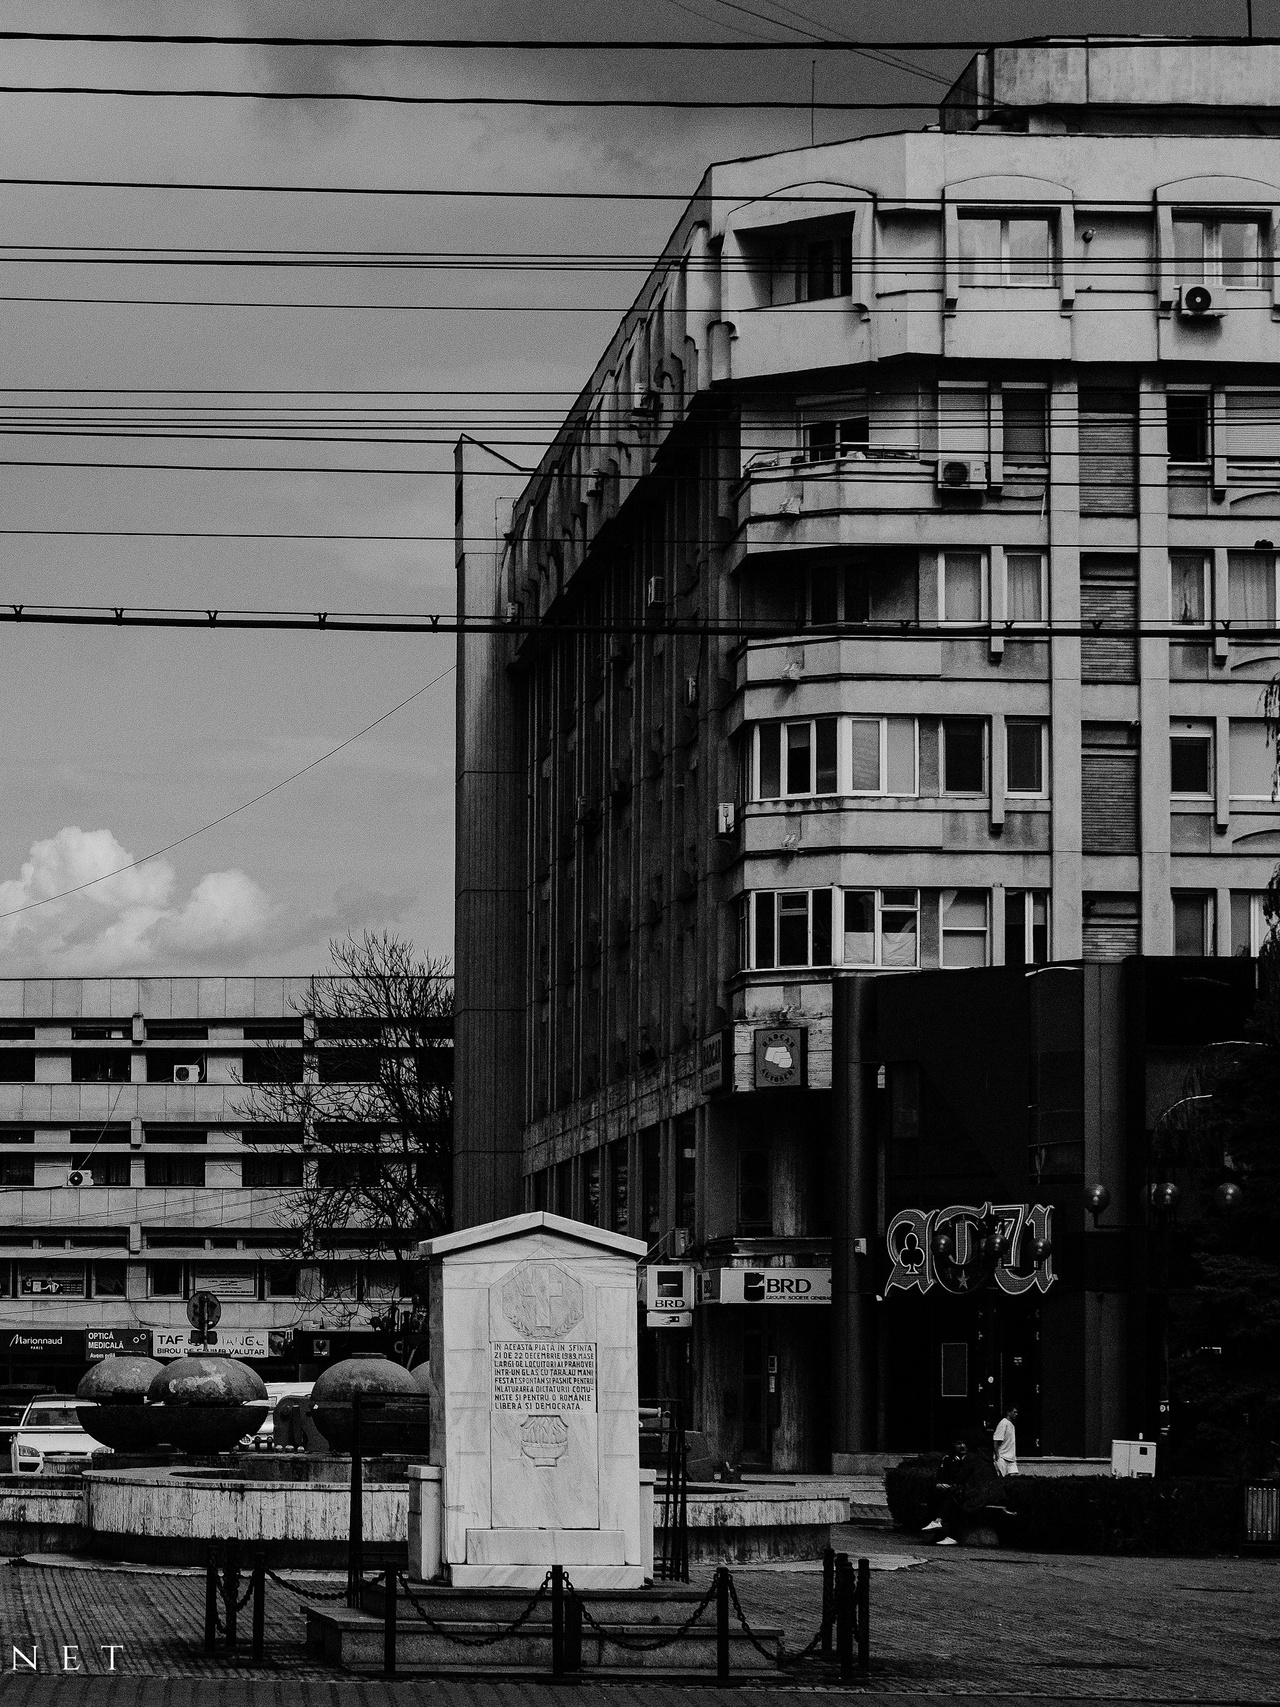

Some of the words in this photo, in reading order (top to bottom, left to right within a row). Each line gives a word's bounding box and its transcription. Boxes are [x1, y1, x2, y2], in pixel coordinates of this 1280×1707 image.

[767, 1278, 811, 1293] BRD
[655, 1300, 685, 1308] BRD
[9, 1333, 63, 1347] Marionnaud
[157, 1334, 183, 1345] TAF
[535, 1385, 569, 1393] DICTATURII
[572, 1385, 594, 1393] COMU-
